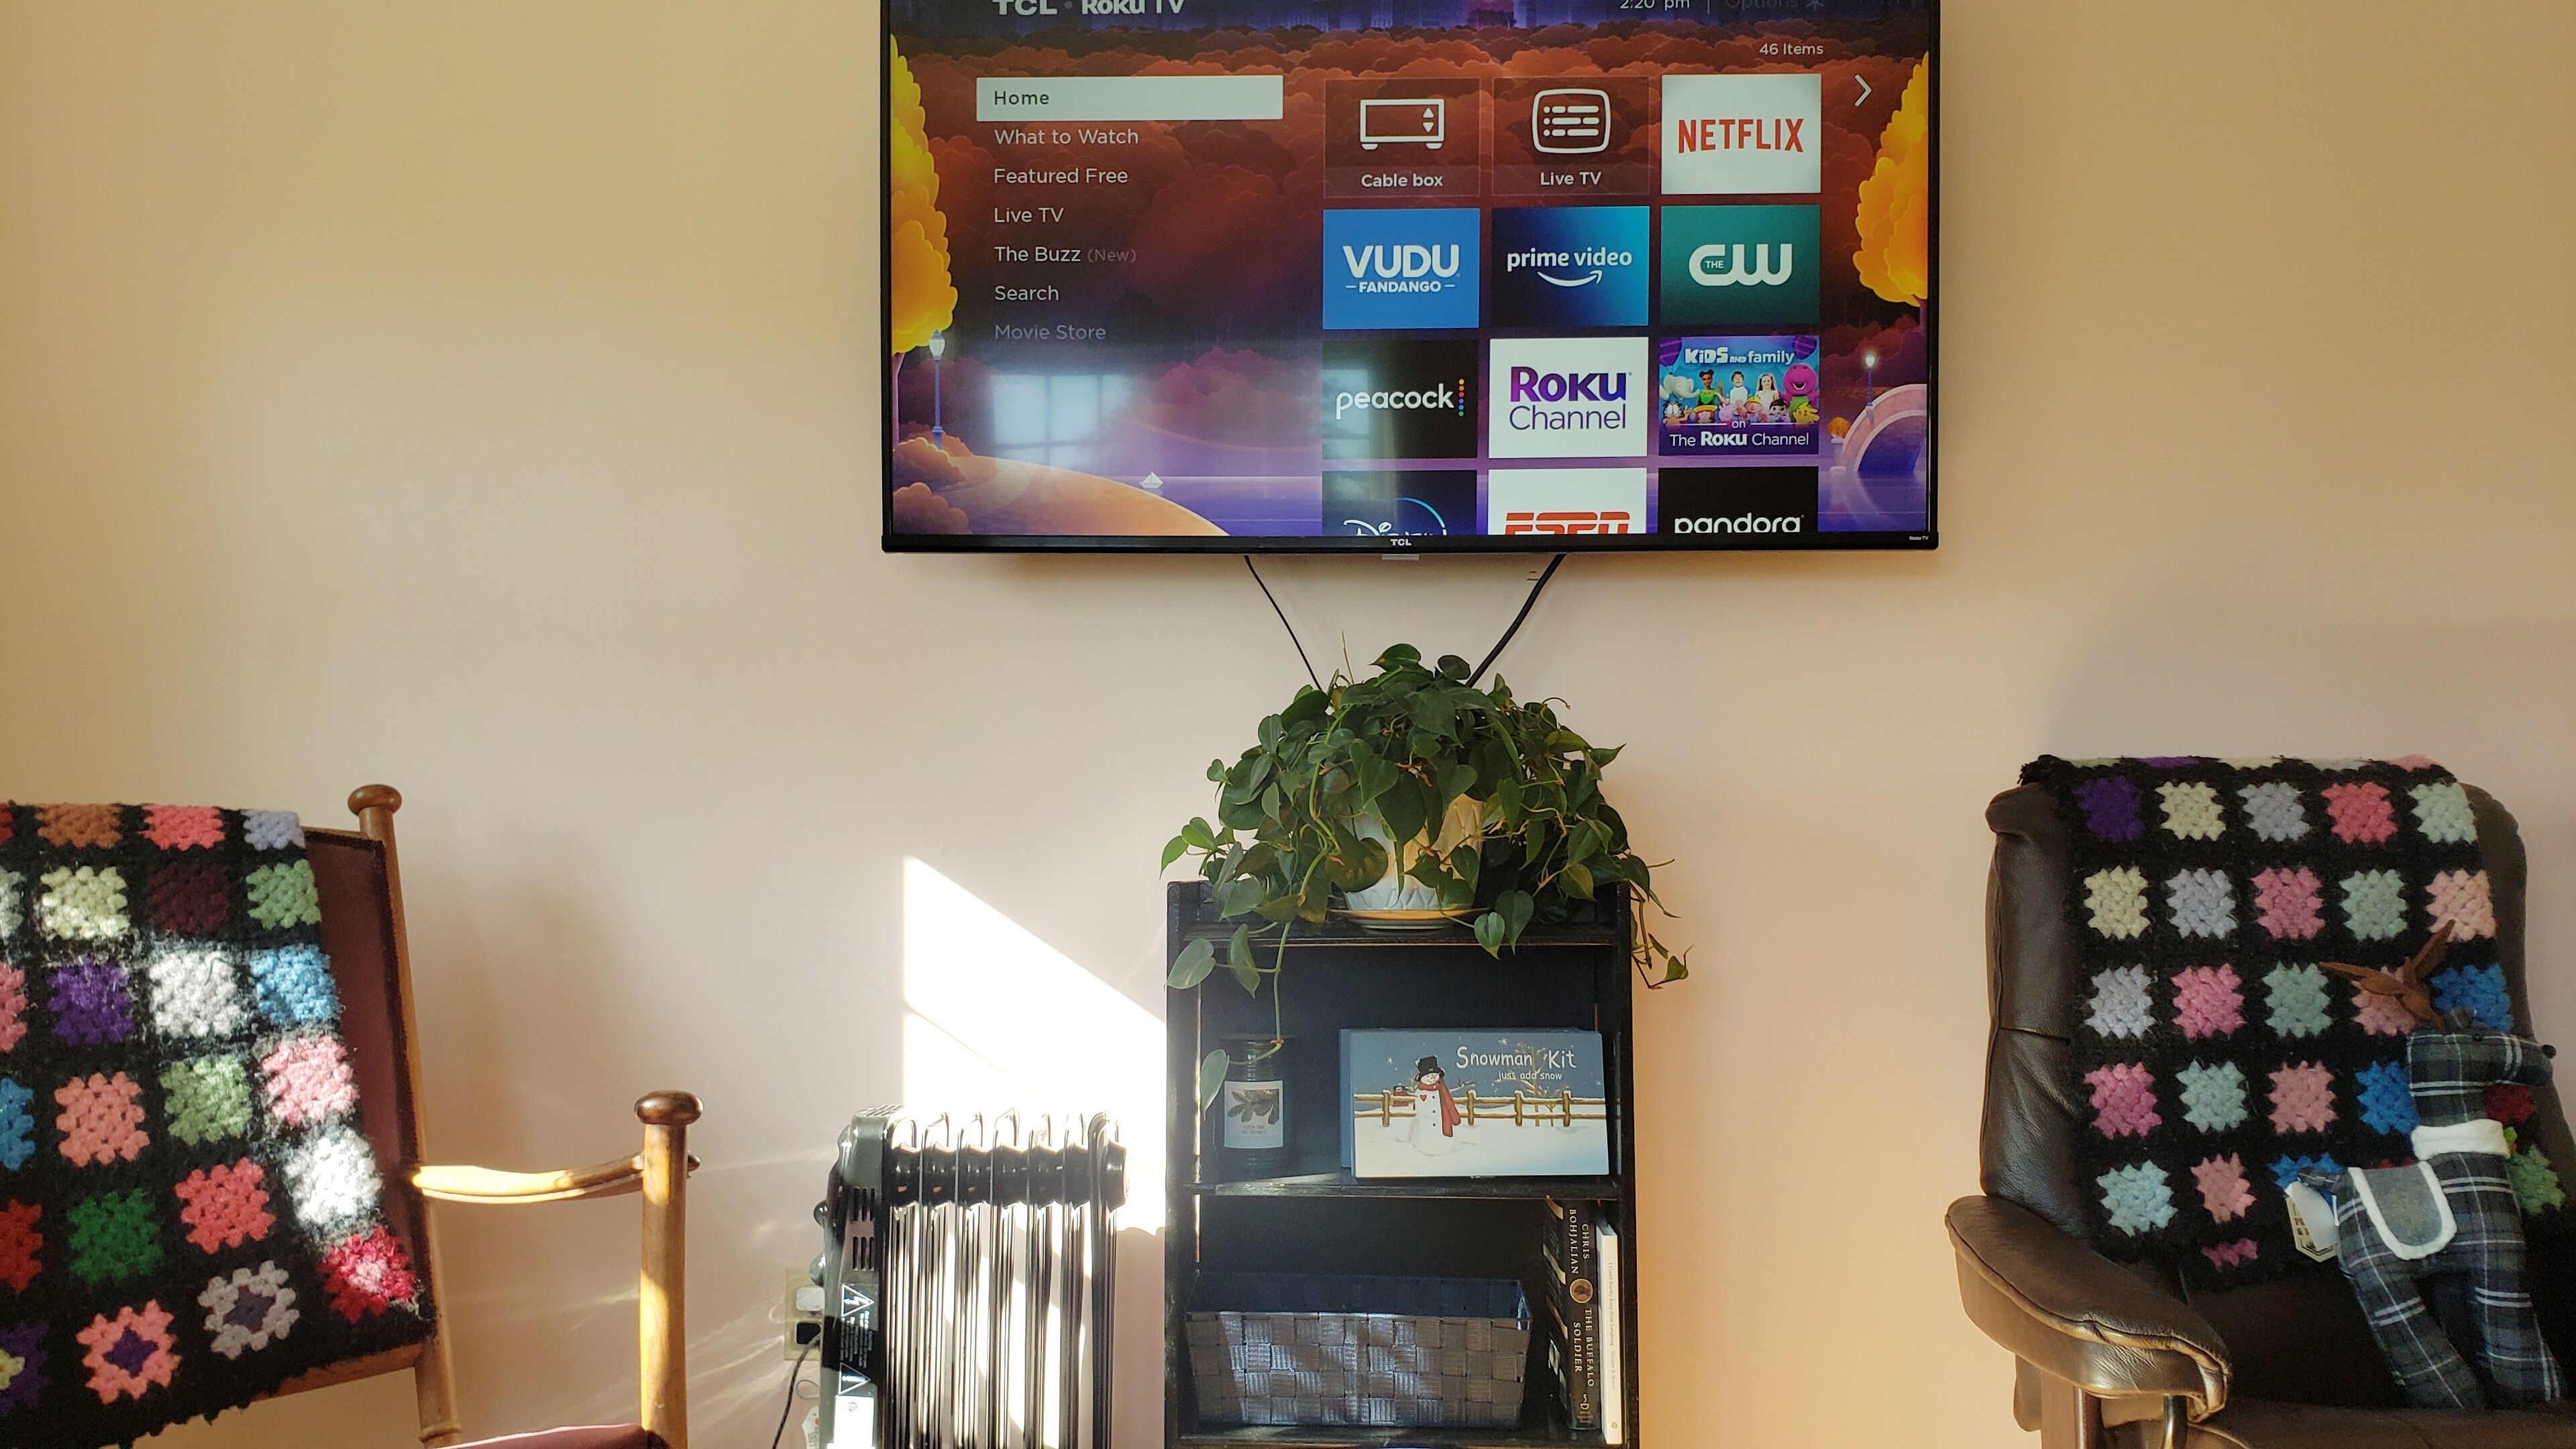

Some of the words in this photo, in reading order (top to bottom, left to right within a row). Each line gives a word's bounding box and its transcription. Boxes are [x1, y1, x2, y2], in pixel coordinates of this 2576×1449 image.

[992, 0, 1058, 15] TCL
[1664, 0, 1690, 11] pm
[1759, 43, 1778, 55] 46
[1783, 43, 1824, 55] Items
[994, 91, 1050, 105] Home
[994, 129, 1045, 145] What
[1052, 129, 1071, 144] to
[1078, 128, 1139, 144] Watch
[1678, 118, 1805, 154] NETFLIX
[994, 168, 1079, 184] Featured
[1086, 168, 1129, 184] Free
[1360, 173, 1408, 188] Cable
[1412, 173, 1444, 187] box
[1540, 172, 1574, 186] Live
[1579, 172, 1602, 185] TV
[994, 207, 1032, 223] Live
[1038, 207, 1065, 223] TV
[994, 246, 1029, 262] The
[1035, 246, 1081, 262] Buzz
[1087, 249, 1136, 263] (New)
[1342, 244, 1460, 278] VUDU
[1507, 247, 1569, 272] prime
[1574, 247, 1633, 267] video
[1688, 244, 1792, 286] CW
[1705, 260, 1724, 269] THE
[995, 285, 1059, 301] Search
[1359, 280, 1442, 293] FANDANGO
[995, 325, 1051, 340] Movie
[1057, 325, 1107, 340] Store
[1729, 356, 1746, 364] AND
[1748, 350, 1795, 366] family
[1336, 383, 1454, 420] peacock
[1509, 403, 1627, 431] Channel
[1731, 421, 1746, 429] on
[1669, 434, 1697, 447] The
[1752, 433, 1809, 446] Channel
[1674, 512, 1801, 534] pandora
[1390, 538, 1412, 546] TCL
[1456, 1045, 1533, 1069] Snowman
[1548, 1050, 1578, 1069] Kit
[1497, 1071, 1516, 1082] just
[1520, 1070, 1538, 1080] add
[1540, 1072, 1562, 1081] snow
[1568, 1209, 1579, 1274] BOHJALIAN
[1581, 1224, 1590, 1259] CHRIS
[1573, 1322, 1582, 1373] SOLDIER
[1586, 1336, 1595, 1387] BUFFALO
